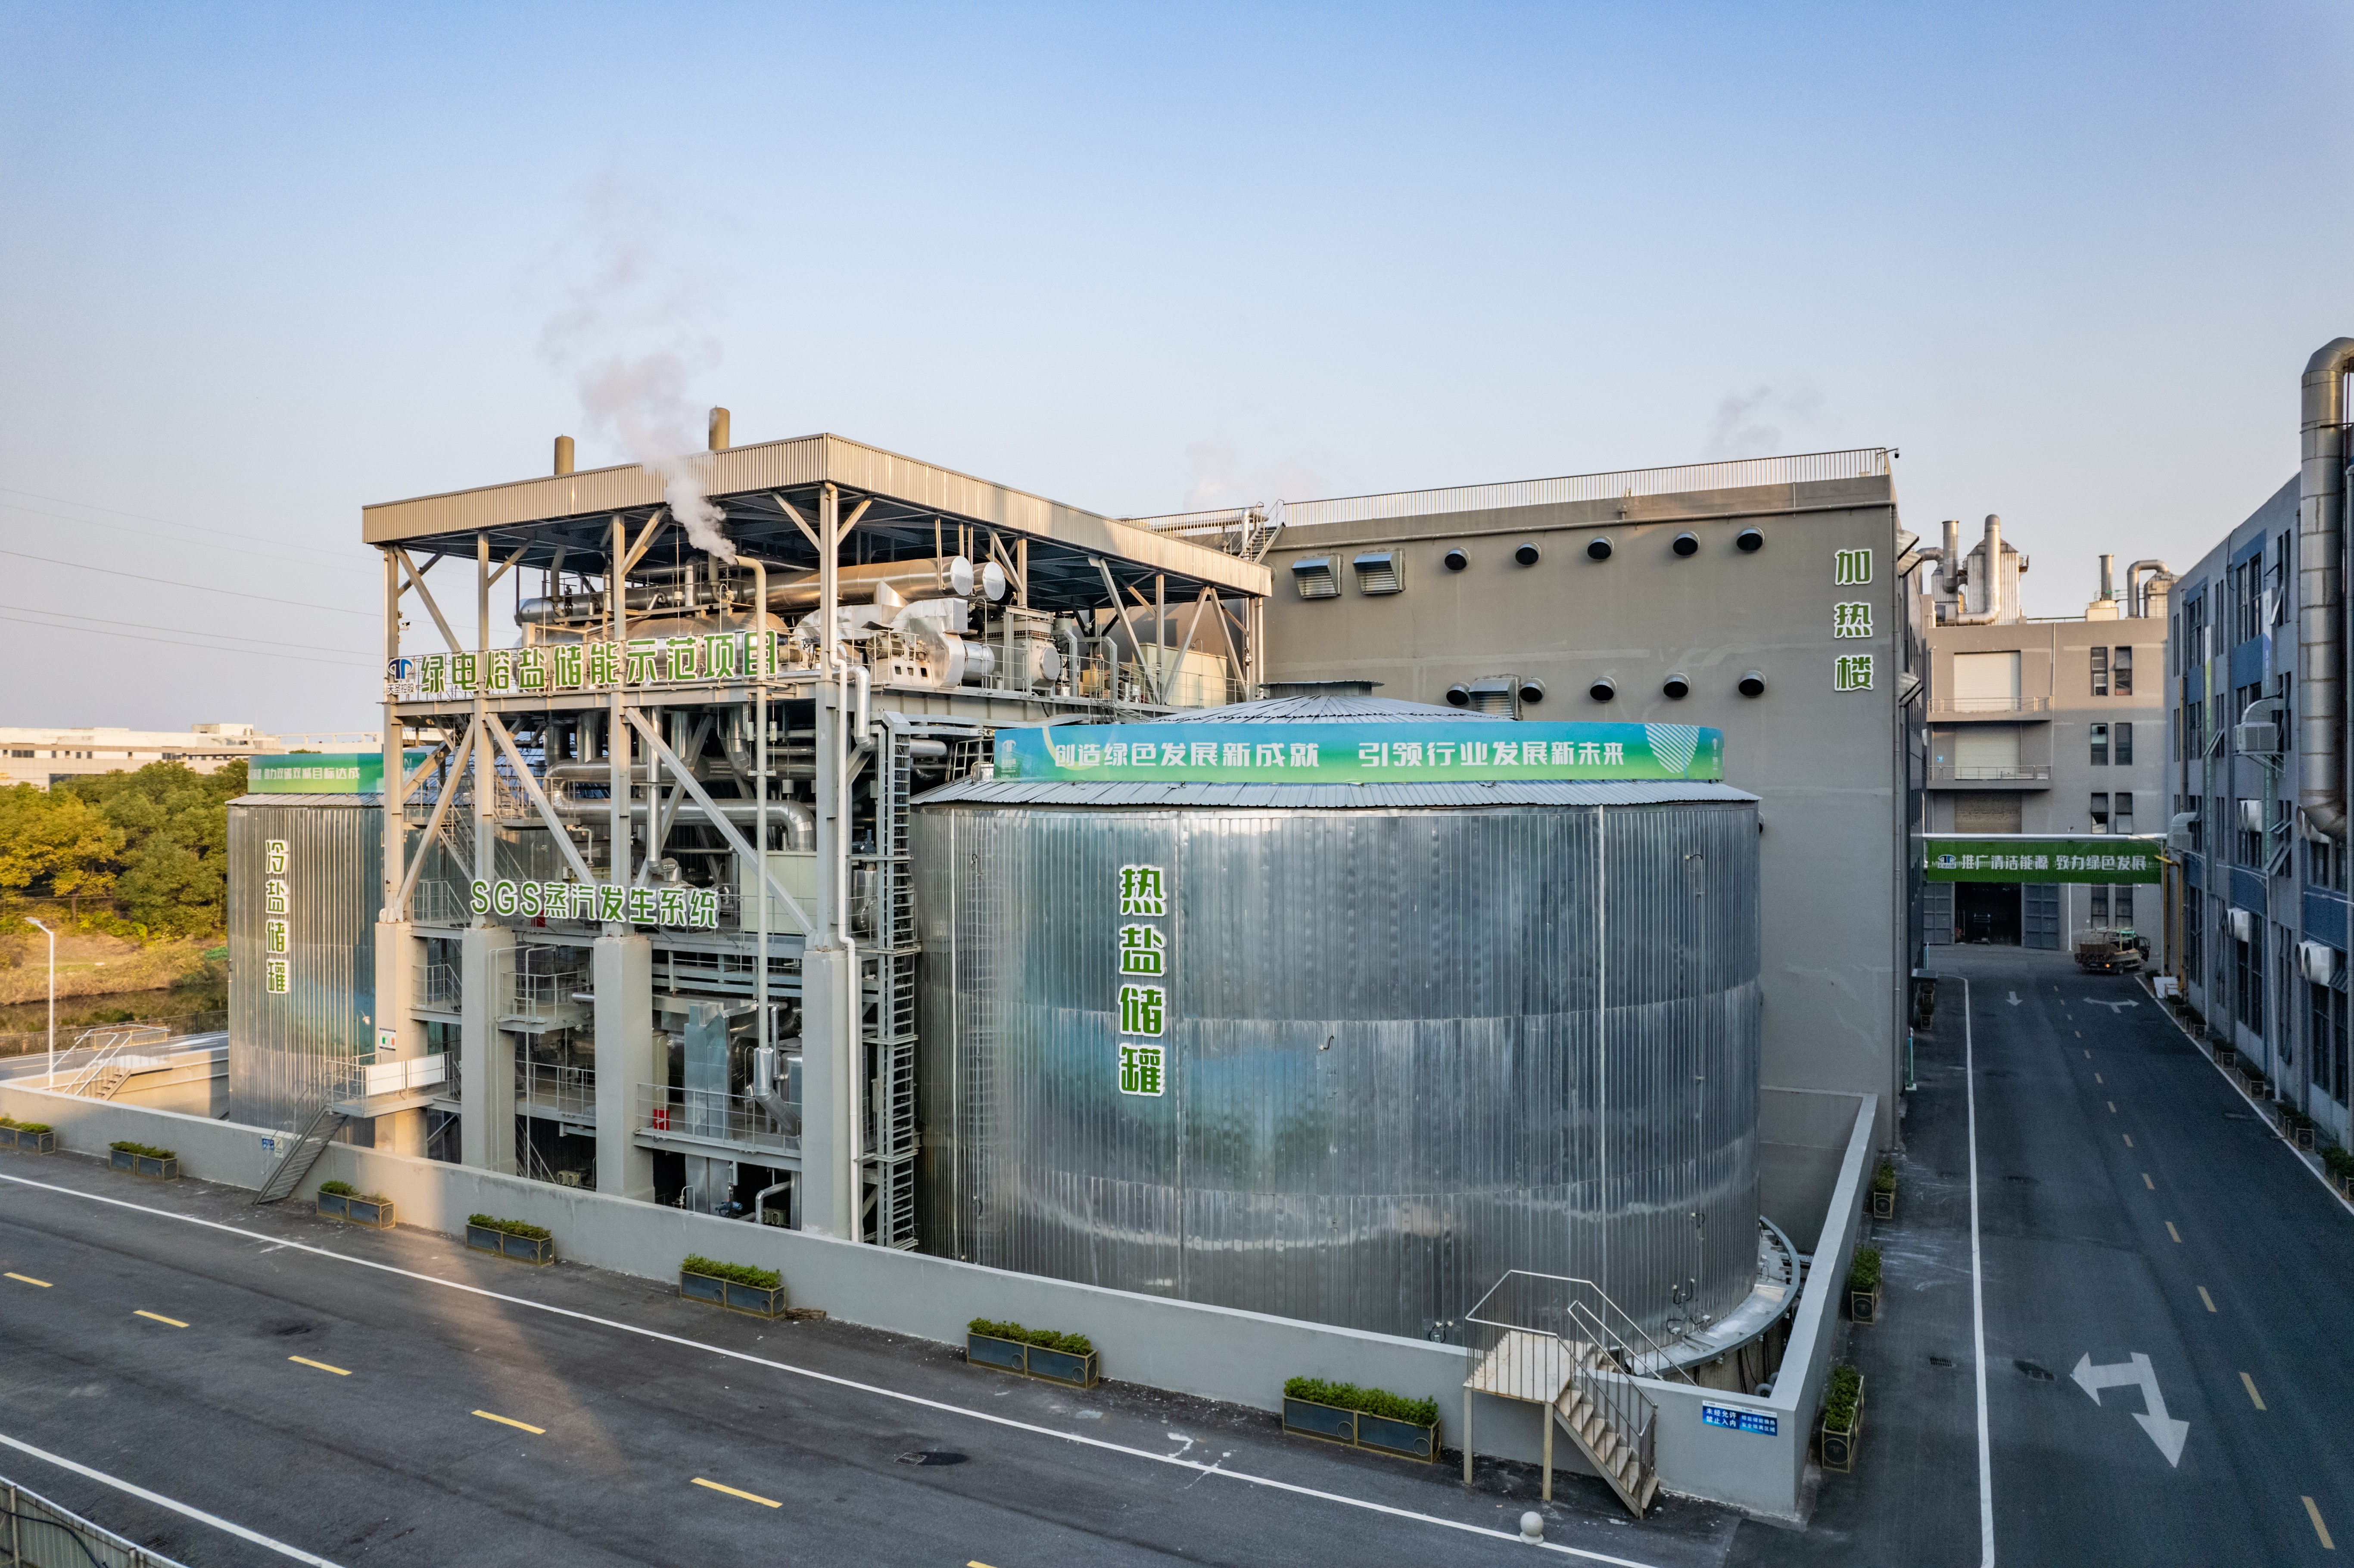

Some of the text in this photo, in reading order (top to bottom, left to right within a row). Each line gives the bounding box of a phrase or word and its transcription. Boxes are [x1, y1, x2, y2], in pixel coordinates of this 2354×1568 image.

[1835, 549, 1873, 691] 加热楼
[420, 630, 778, 694] 绿电熔盐储能示范项目
[388, 683, 414, 693] 天圣控股
[1055, 741, 1624, 767] 创造绿色发展新成就 引领行业发展新未来
[1962, 855, 2145, 871] 推广清洁能源 致力绿色发展
[266, 840, 289, 994] 冷盐储罐
[470, 879, 719, 928] SGS蒸汽发生系统
[1119, 865, 1165, 1096] 热盐储罐
[1706, 1408, 1737, 1419] 未经允许
[1706, 1416, 1736, 1427] 禁止入内
